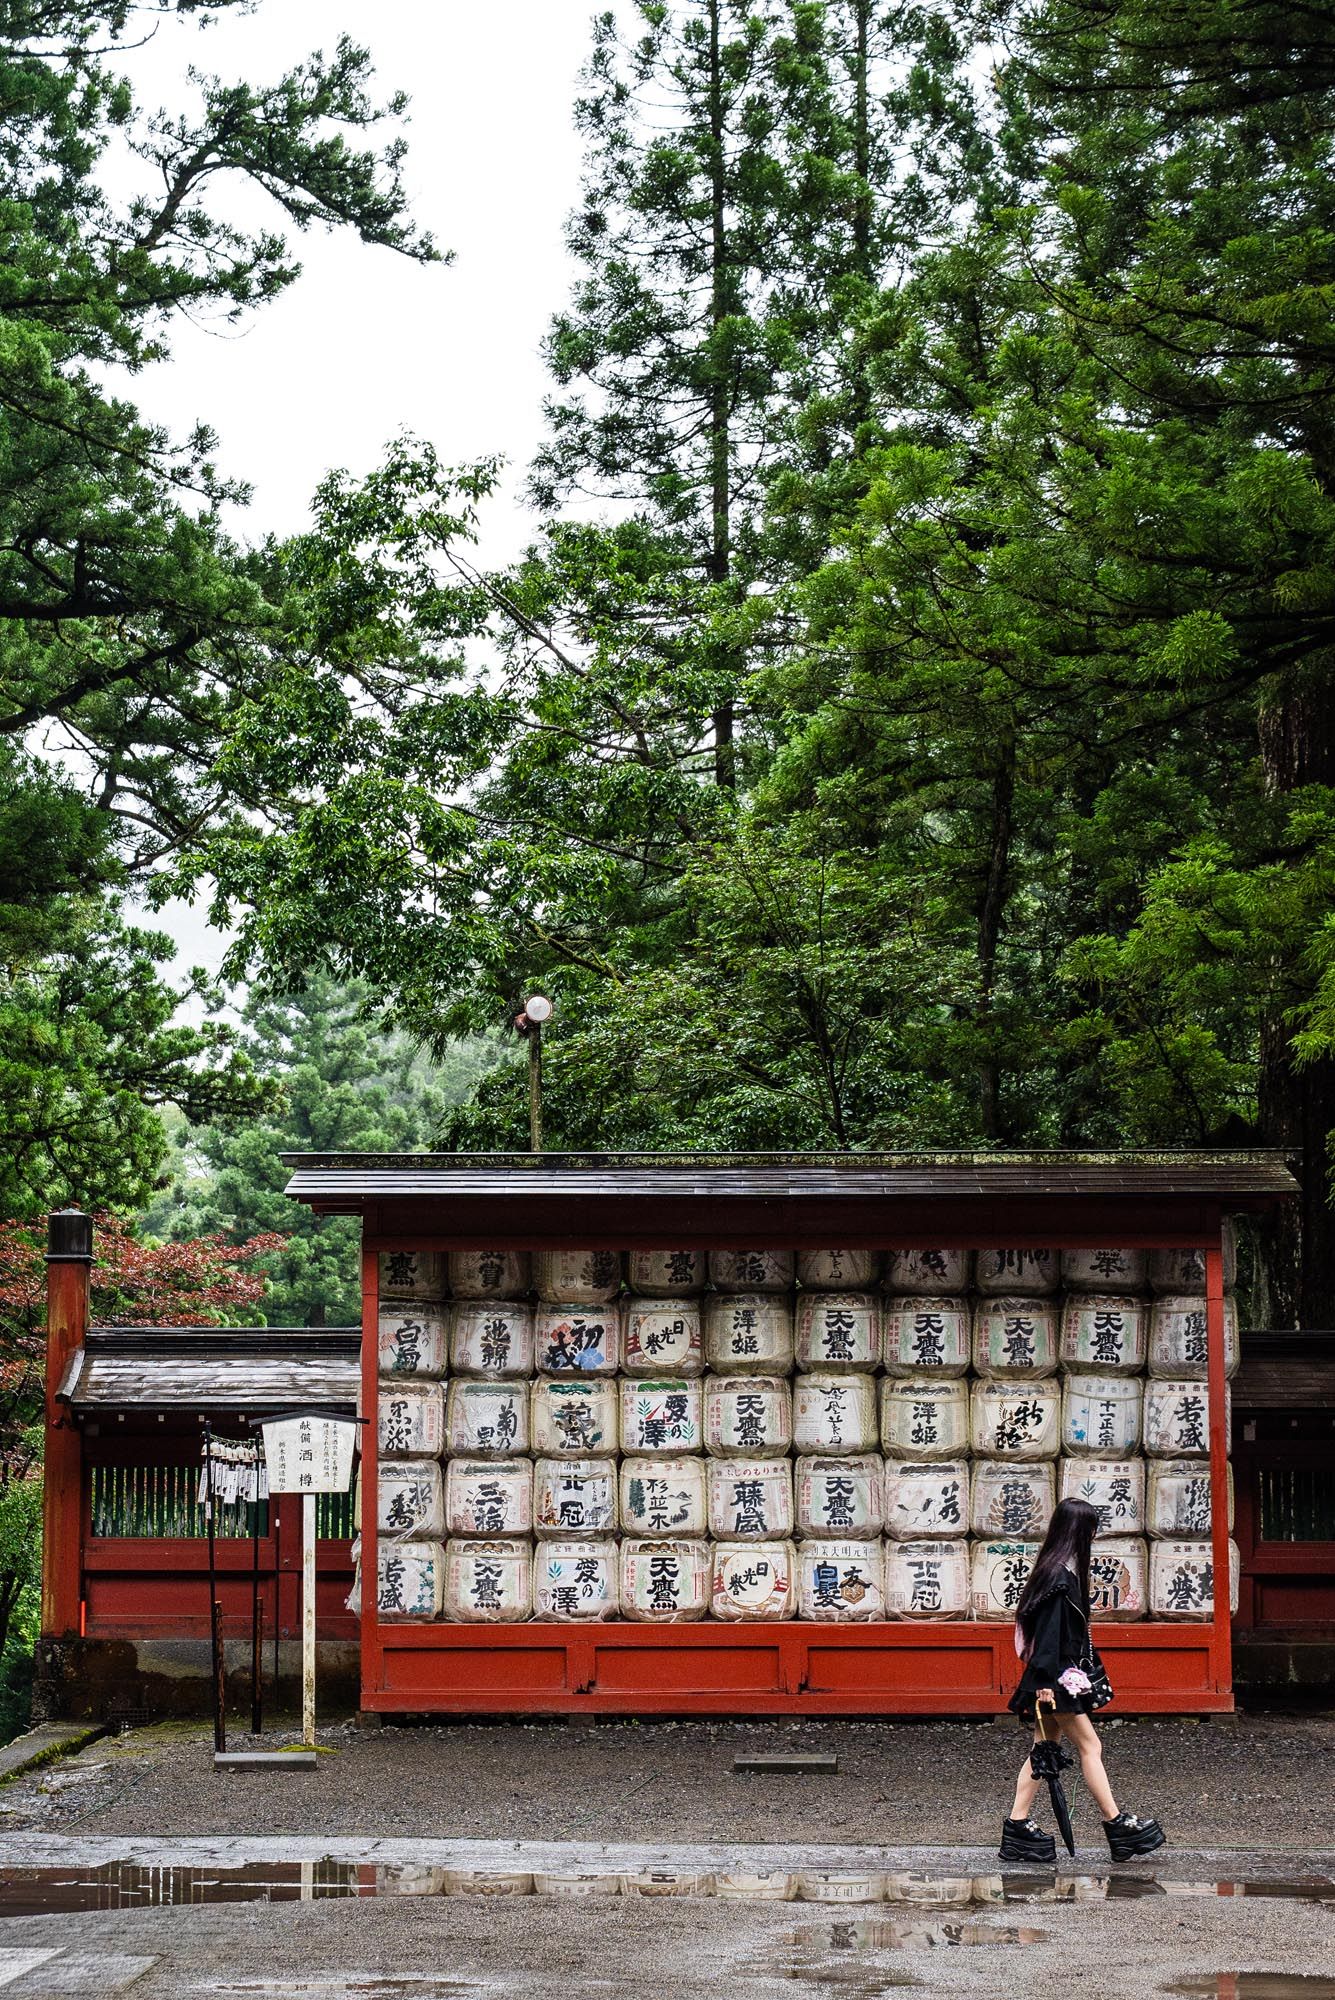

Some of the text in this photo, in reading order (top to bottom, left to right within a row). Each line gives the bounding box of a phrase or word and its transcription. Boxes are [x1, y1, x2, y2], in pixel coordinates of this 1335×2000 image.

[731, 1309, 759, 1355] 澤姫
[822, 1309, 856, 1361] 天鷹
[911, 1313, 945, 1365] 天鷹
[1002, 1317, 1036, 1367] 天鷹
[1089, 1311, 1124, 1364] 天鷹
[733, 1394, 767, 1446] 天鷹
[911, 1402, 938, 1445] 澤姫
[1098, 1400, 1116, 1447] 十一正宗
[1173, 1396, 1207, 1451] 若盛
[646, 1478, 671, 1530] 杉並木
[822, 1476, 856, 1526] 天鷹
[646, 1557, 680, 1611] 天鷹
